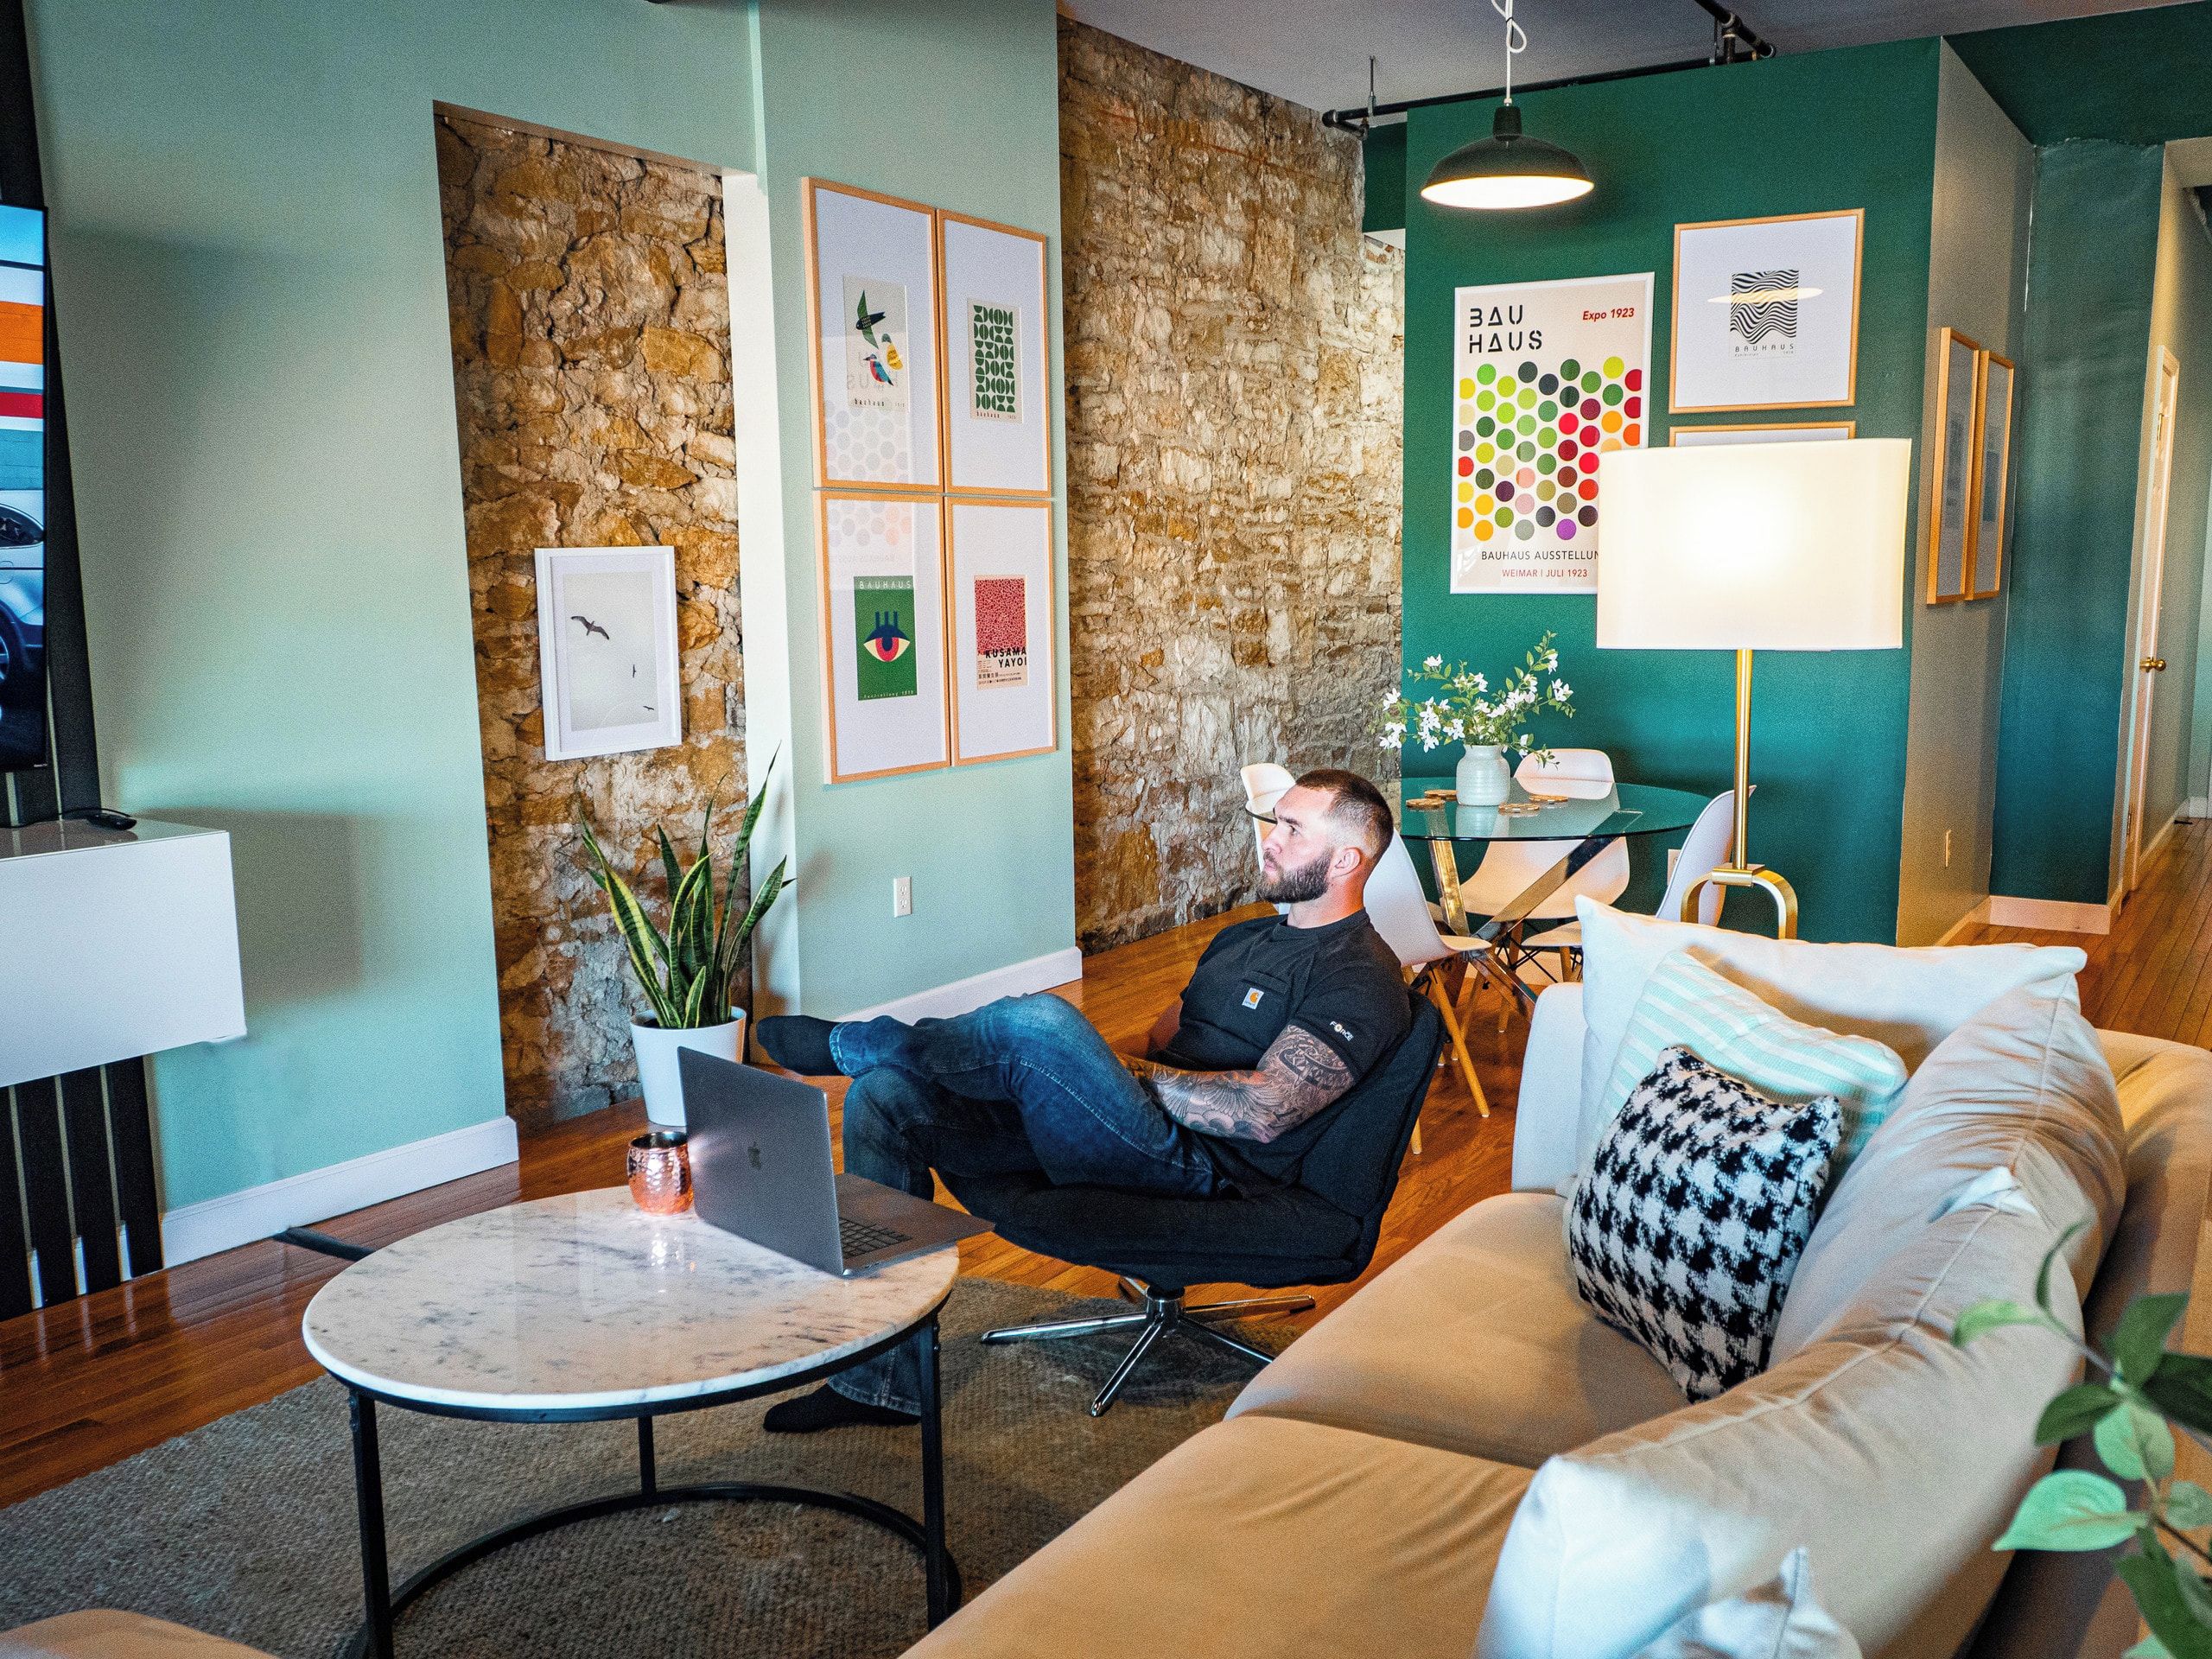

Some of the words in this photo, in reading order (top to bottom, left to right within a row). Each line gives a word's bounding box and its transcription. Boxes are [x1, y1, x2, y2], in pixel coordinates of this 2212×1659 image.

[1470, 304, 1523, 327] BAU
[1582, 309, 1608, 322] Expo
[1610, 307, 1636, 319] 1923
[1469, 329, 1543, 353] HAUS
[1735, 343, 1794, 353] BAUHAUS
[1481, 550, 1530, 561] BAUHAUS
[1502, 569, 1538, 577] WEIMAR
[1545, 569, 1564, 577] JULI
[1567, 569, 1588, 577] 1923
[859, 580, 912, 589] BAUHAUS
[985, 646, 1027, 658] KUSAMA
[998, 657, 1027, 668] YAYOI
[1329, 1020, 1354, 1041] FORCE
